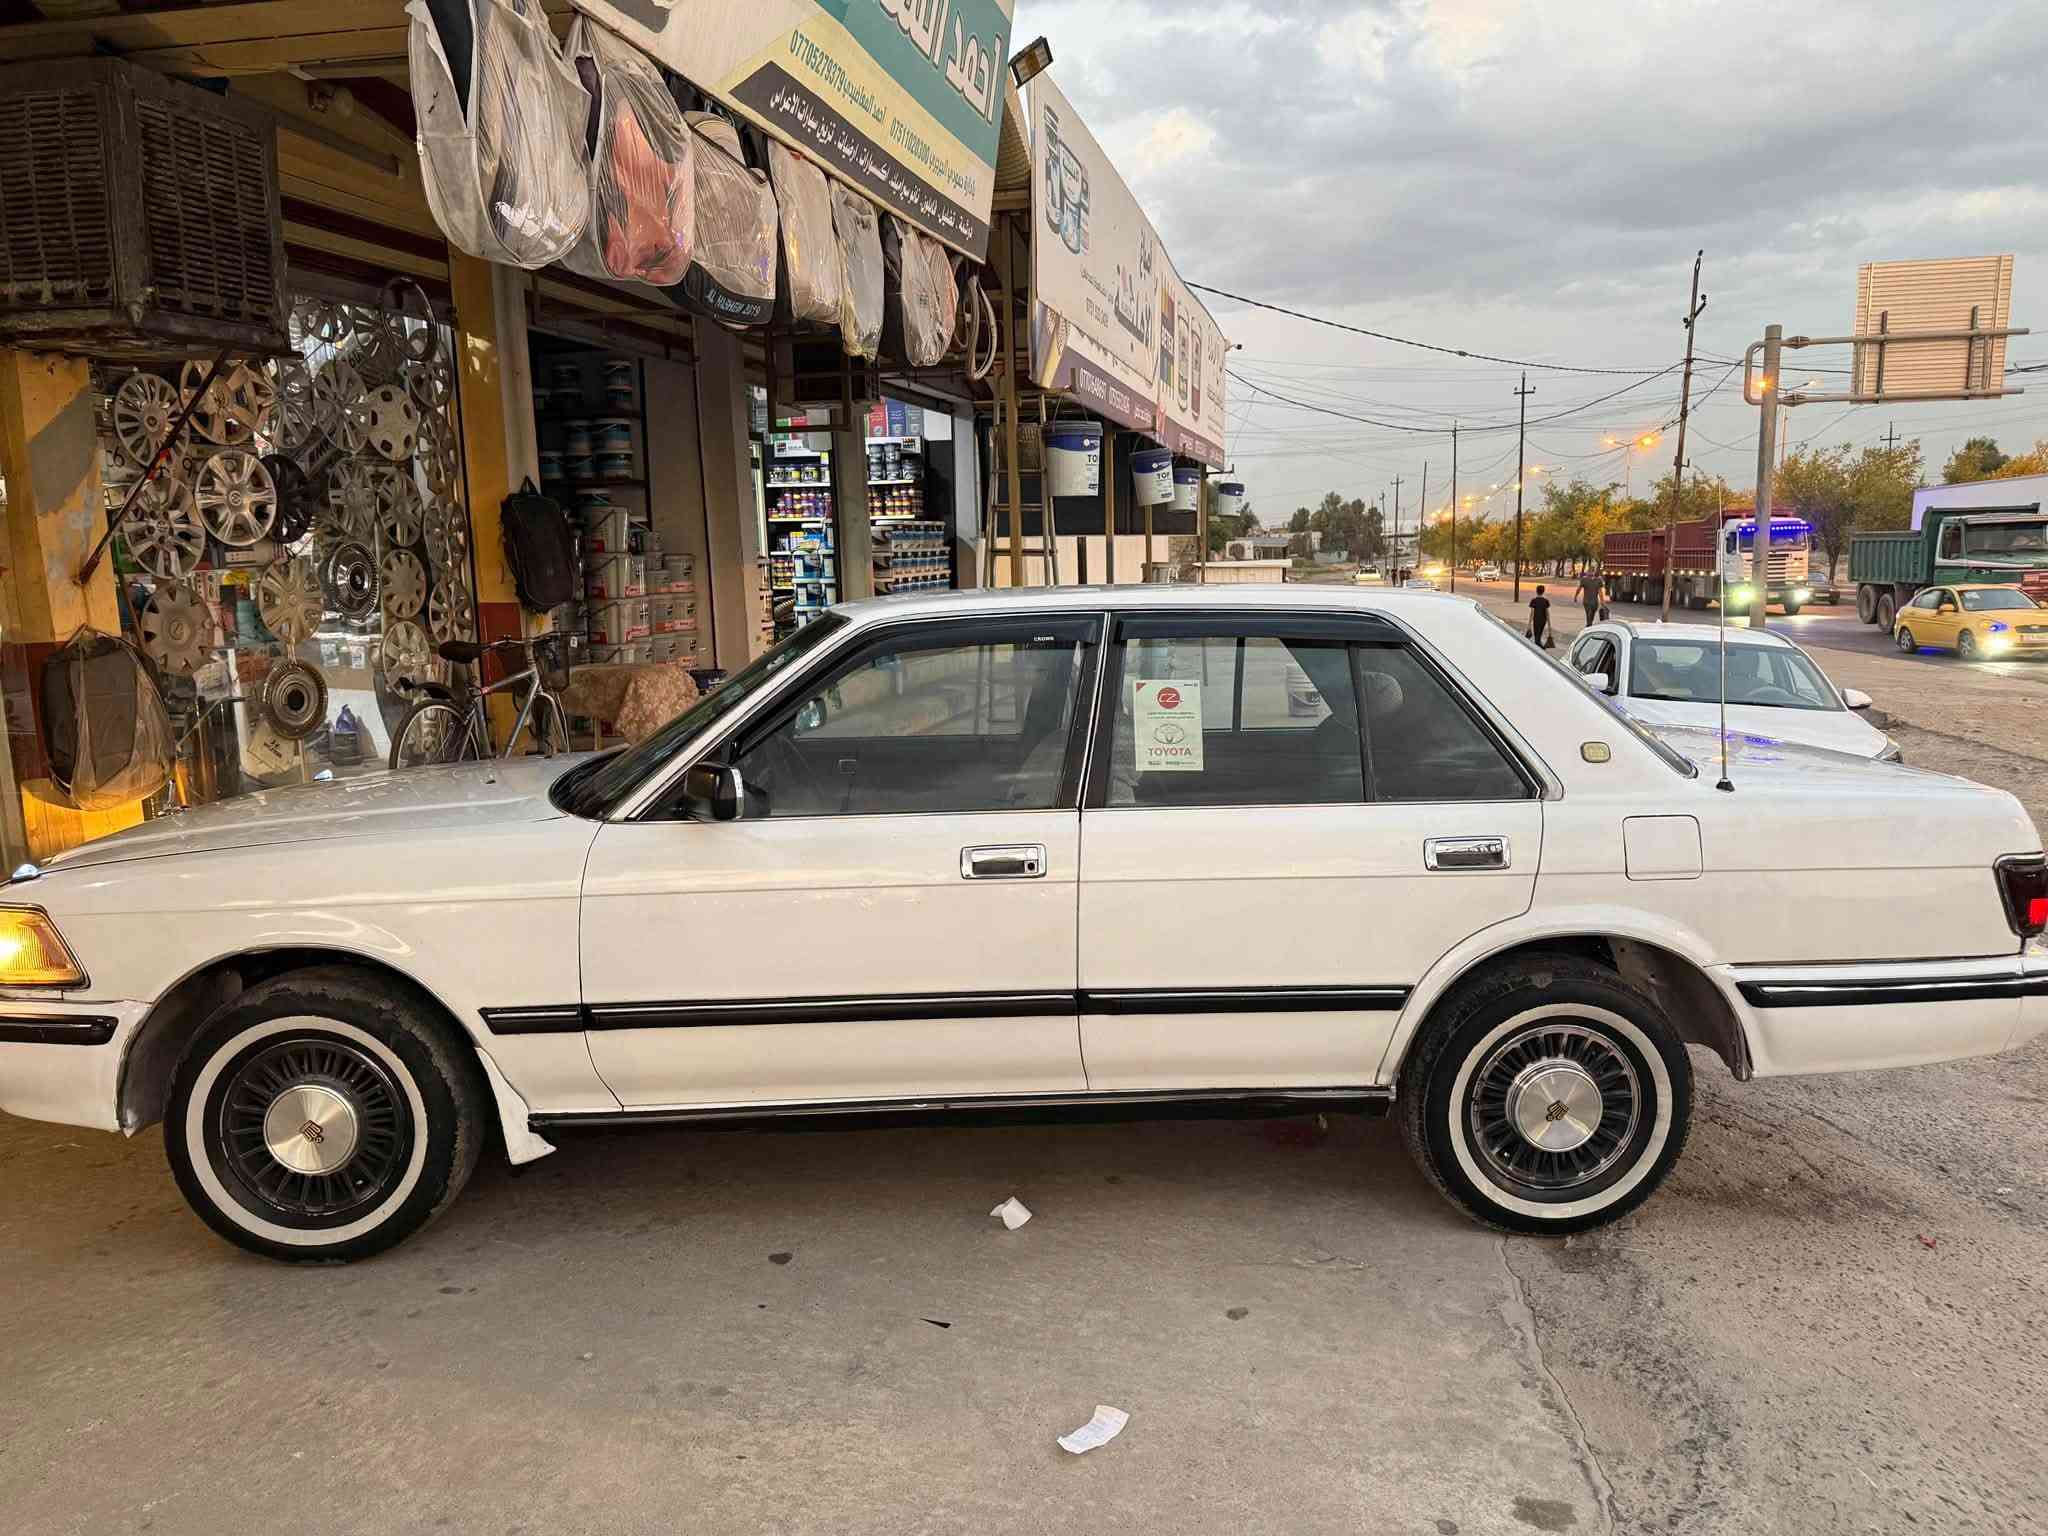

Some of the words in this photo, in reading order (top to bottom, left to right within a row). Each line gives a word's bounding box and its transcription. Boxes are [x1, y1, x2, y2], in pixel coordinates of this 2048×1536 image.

[790, 28, 846, 93] 07705279379
[945, 8, 1002, 126] احمد
[1147, 747, 1192, 757] TOYOTA
